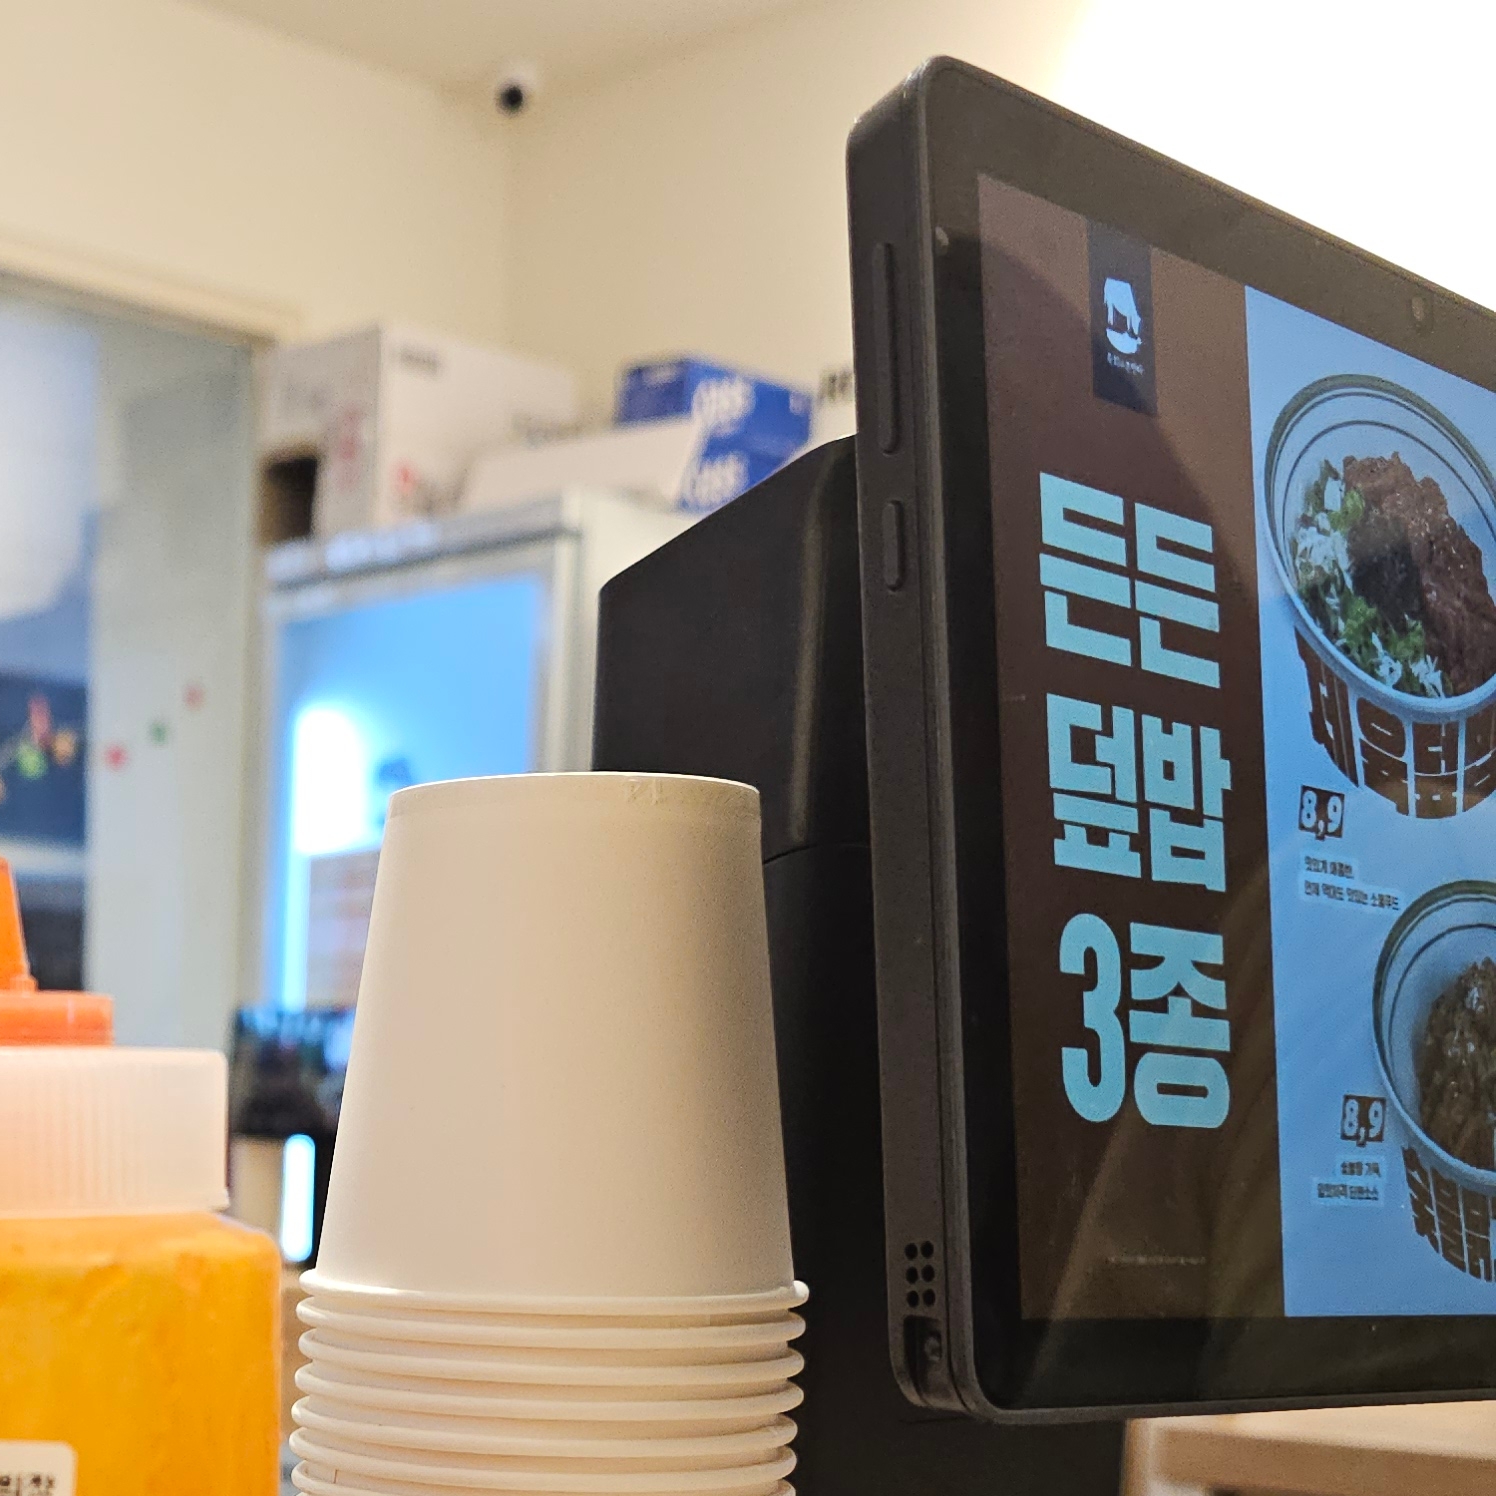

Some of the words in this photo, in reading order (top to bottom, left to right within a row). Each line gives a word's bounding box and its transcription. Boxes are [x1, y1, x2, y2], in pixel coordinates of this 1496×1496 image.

[1039, 471, 1220, 689] 든든
[1046, 692, 1232, 892] 덮밥
[1059, 913, 1231, 1129] 3종
